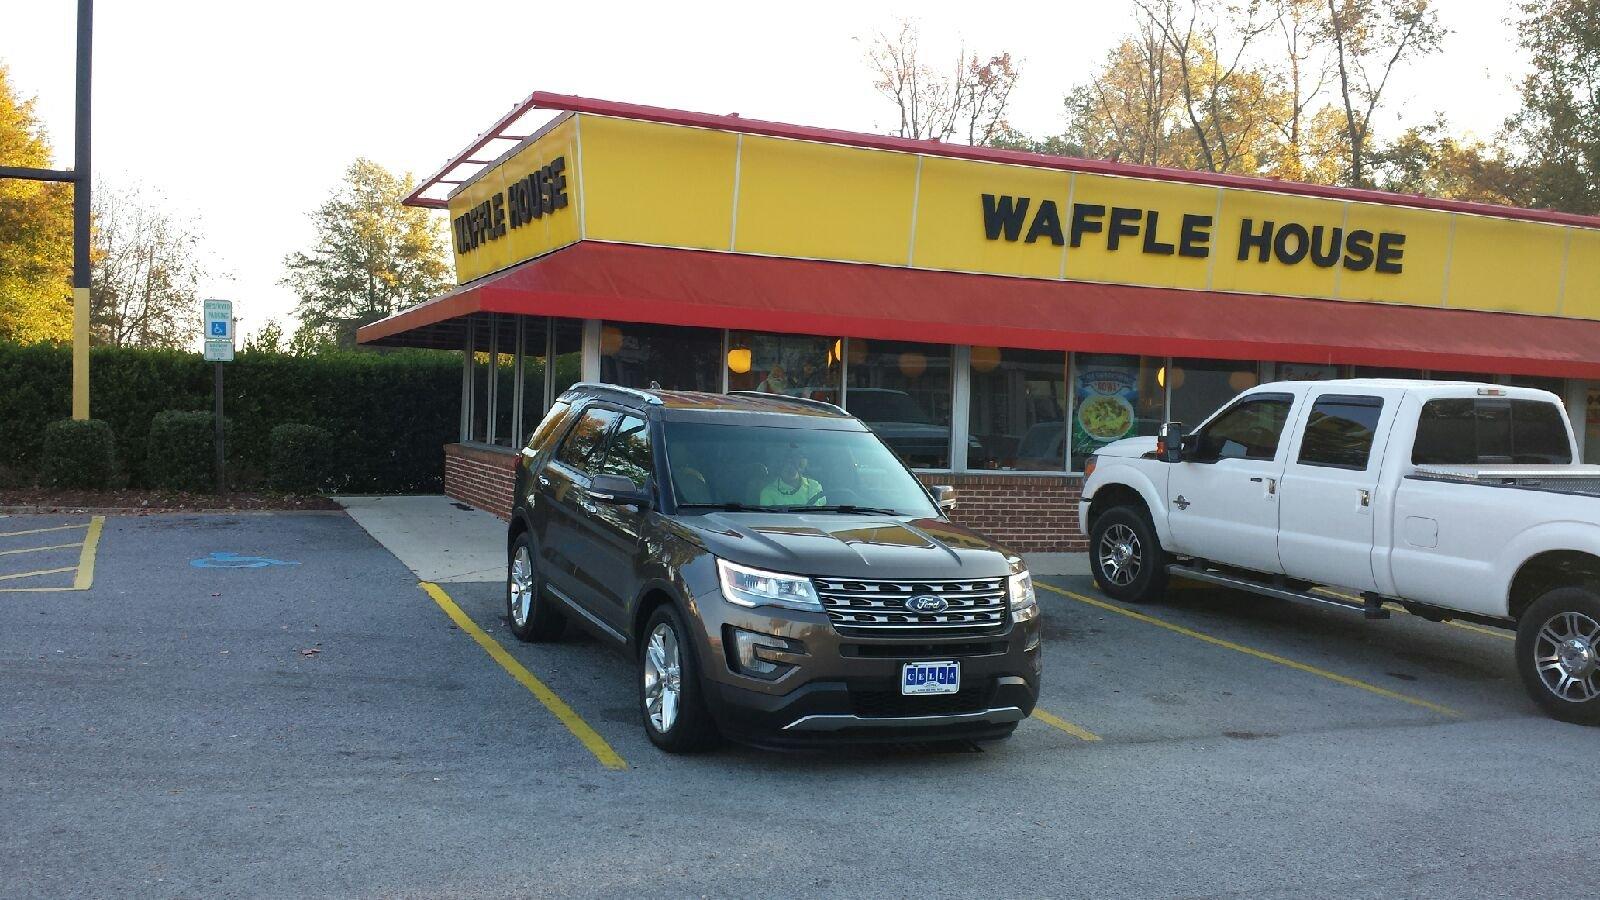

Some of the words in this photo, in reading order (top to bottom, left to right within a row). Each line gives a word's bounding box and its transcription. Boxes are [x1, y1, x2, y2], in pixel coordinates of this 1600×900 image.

[454, 192, 506, 255] WAFFLE
[508, 156, 568, 229] HOUSE
[981, 193, 1213, 258] WAFFLE
[1237, 218, 1406, 274] HOUSE
[917, 597, 940, 609] Ford
[907, 672, 955, 681] CELLA
